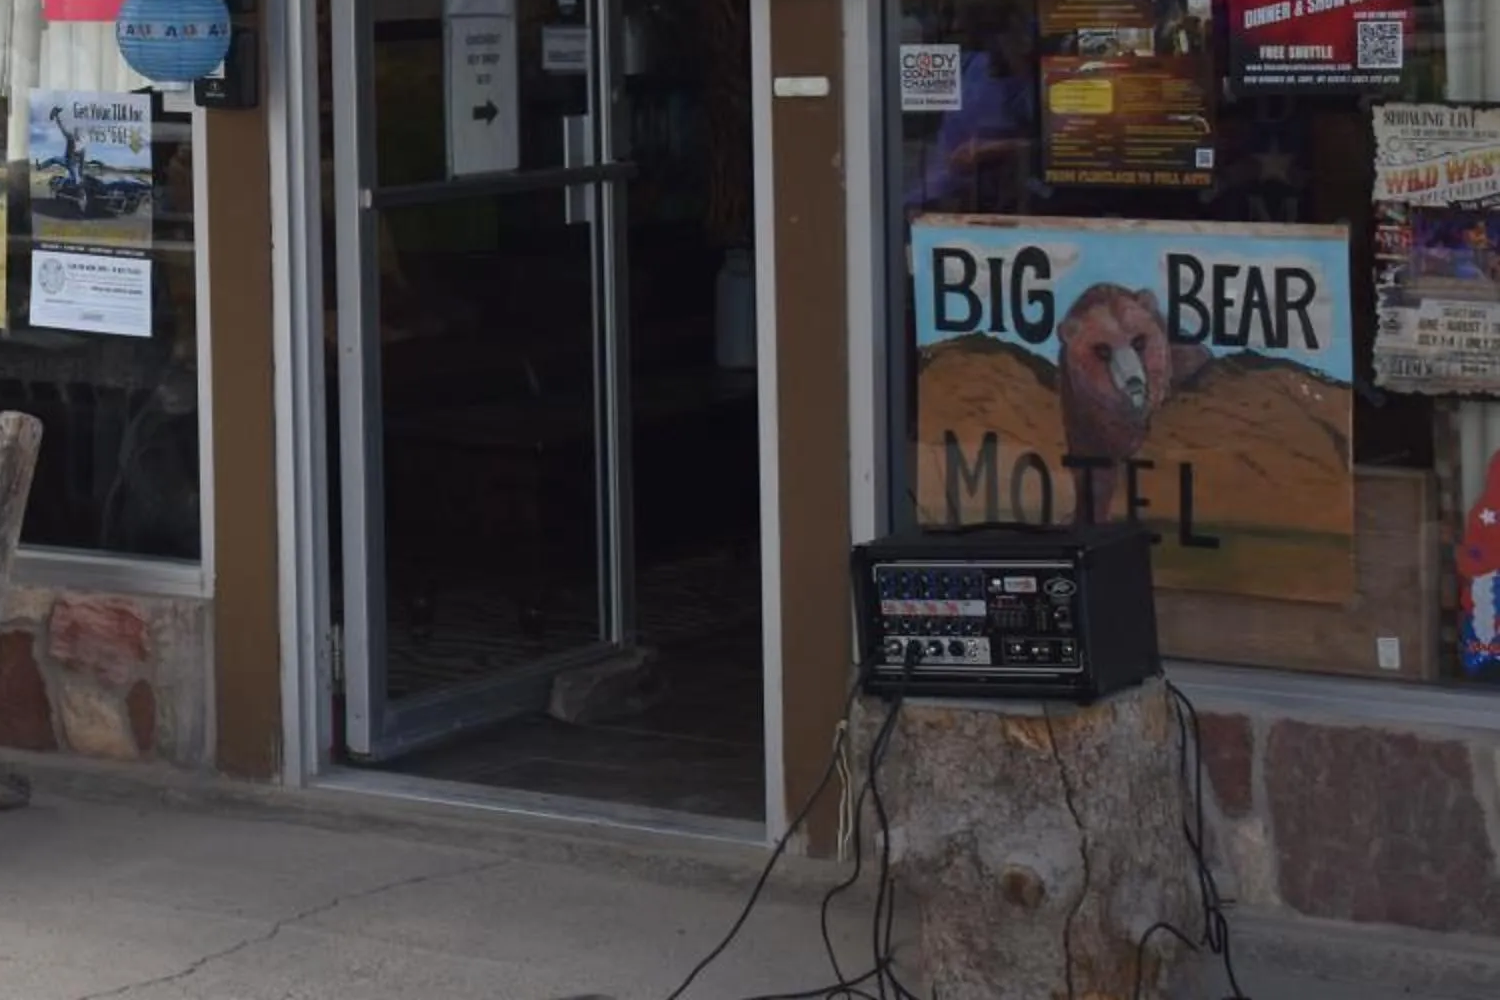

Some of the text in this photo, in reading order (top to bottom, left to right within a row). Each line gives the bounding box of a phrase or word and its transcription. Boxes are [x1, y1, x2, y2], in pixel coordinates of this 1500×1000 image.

[1243, 1, 1291, 30] DINNER
[1293, 1, 1303, 17] &
[903, 53, 958, 69] CODY
[1384, 109, 1444, 128] SHOWING
[1385, 162, 1440, 195] WILD
[931, 245, 1319, 350] BIG BEAR
[944, 430, 1220, 549] MOTEL
